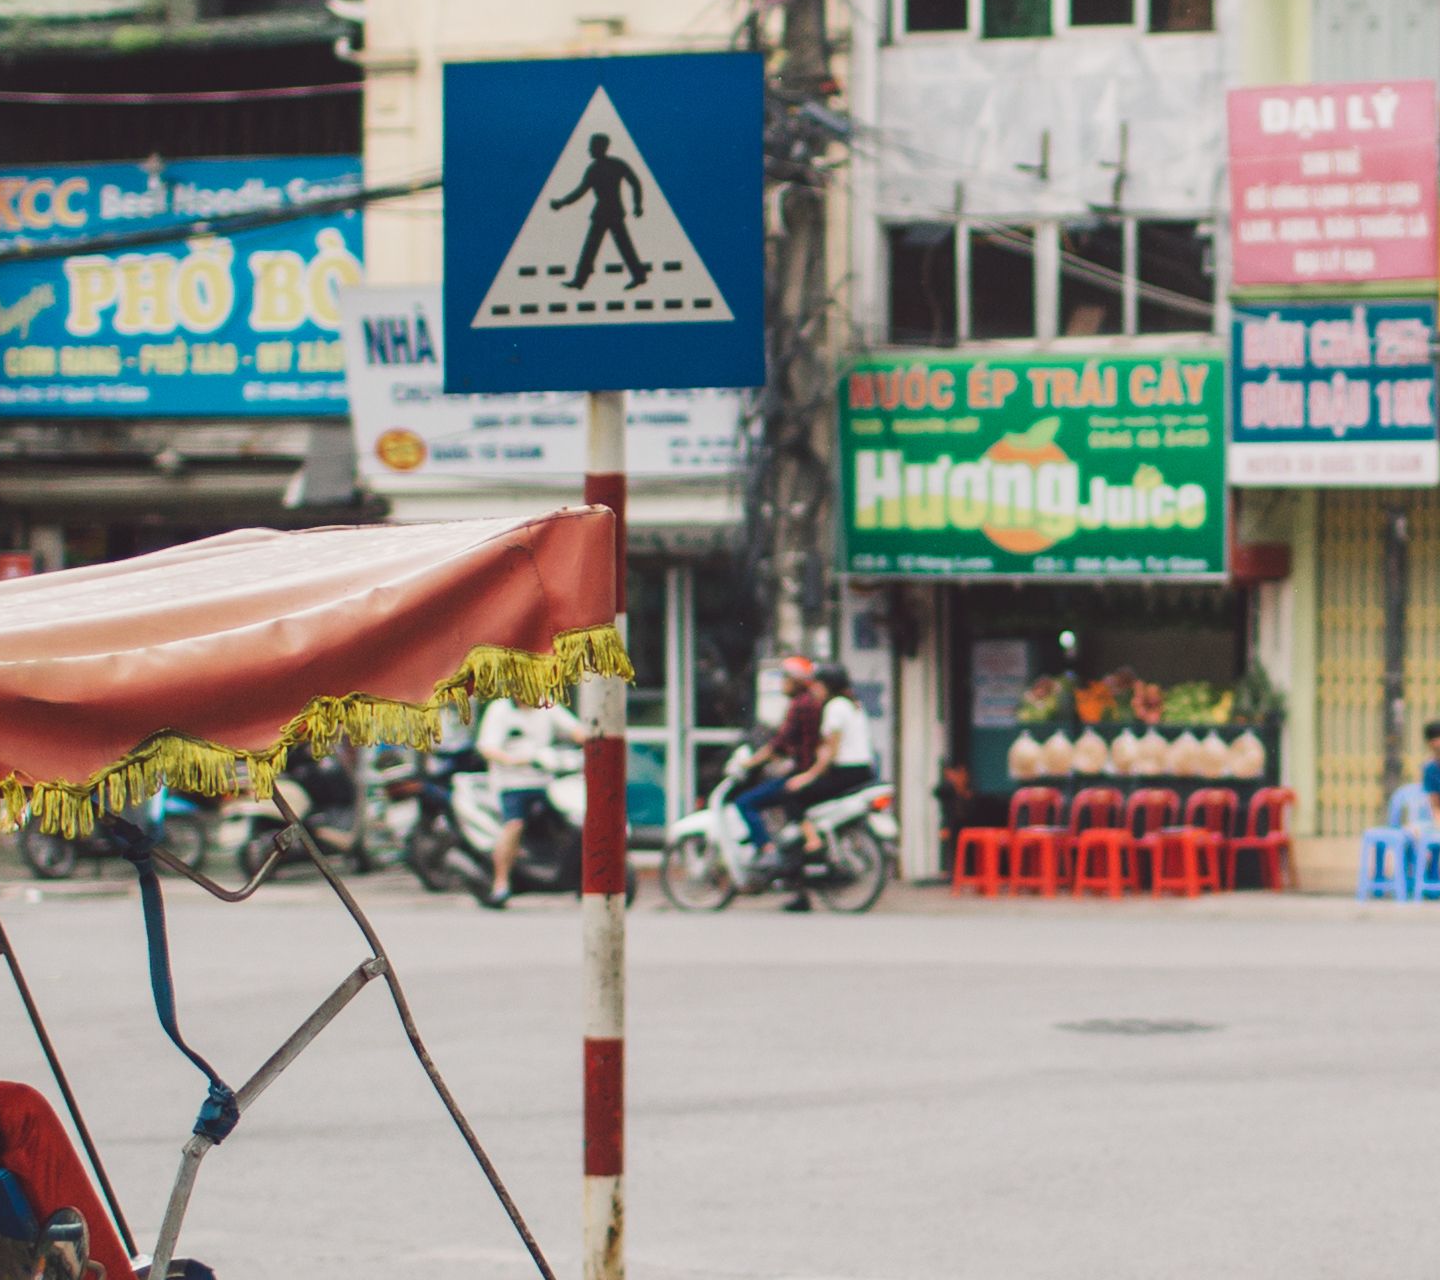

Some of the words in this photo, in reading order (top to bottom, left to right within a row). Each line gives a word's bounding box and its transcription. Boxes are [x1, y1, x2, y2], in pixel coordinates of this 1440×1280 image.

[1260, 96, 1335, 140] ĐẠI
[1345, 86, 1400, 132] LÝ
[63, 234, 235, 337] PHỞ
[362, 302, 437, 365] NHÀ
[849, 362, 955, 410] NƯỚC
[966, 360, 1018, 410] ÉP
[1025, 359, 1118, 409] TRÁI
[1128, 358, 1210, 408] CÂY
[854, 448, 1080, 540] Hương
[1078, 475, 1208, 530] Juice
